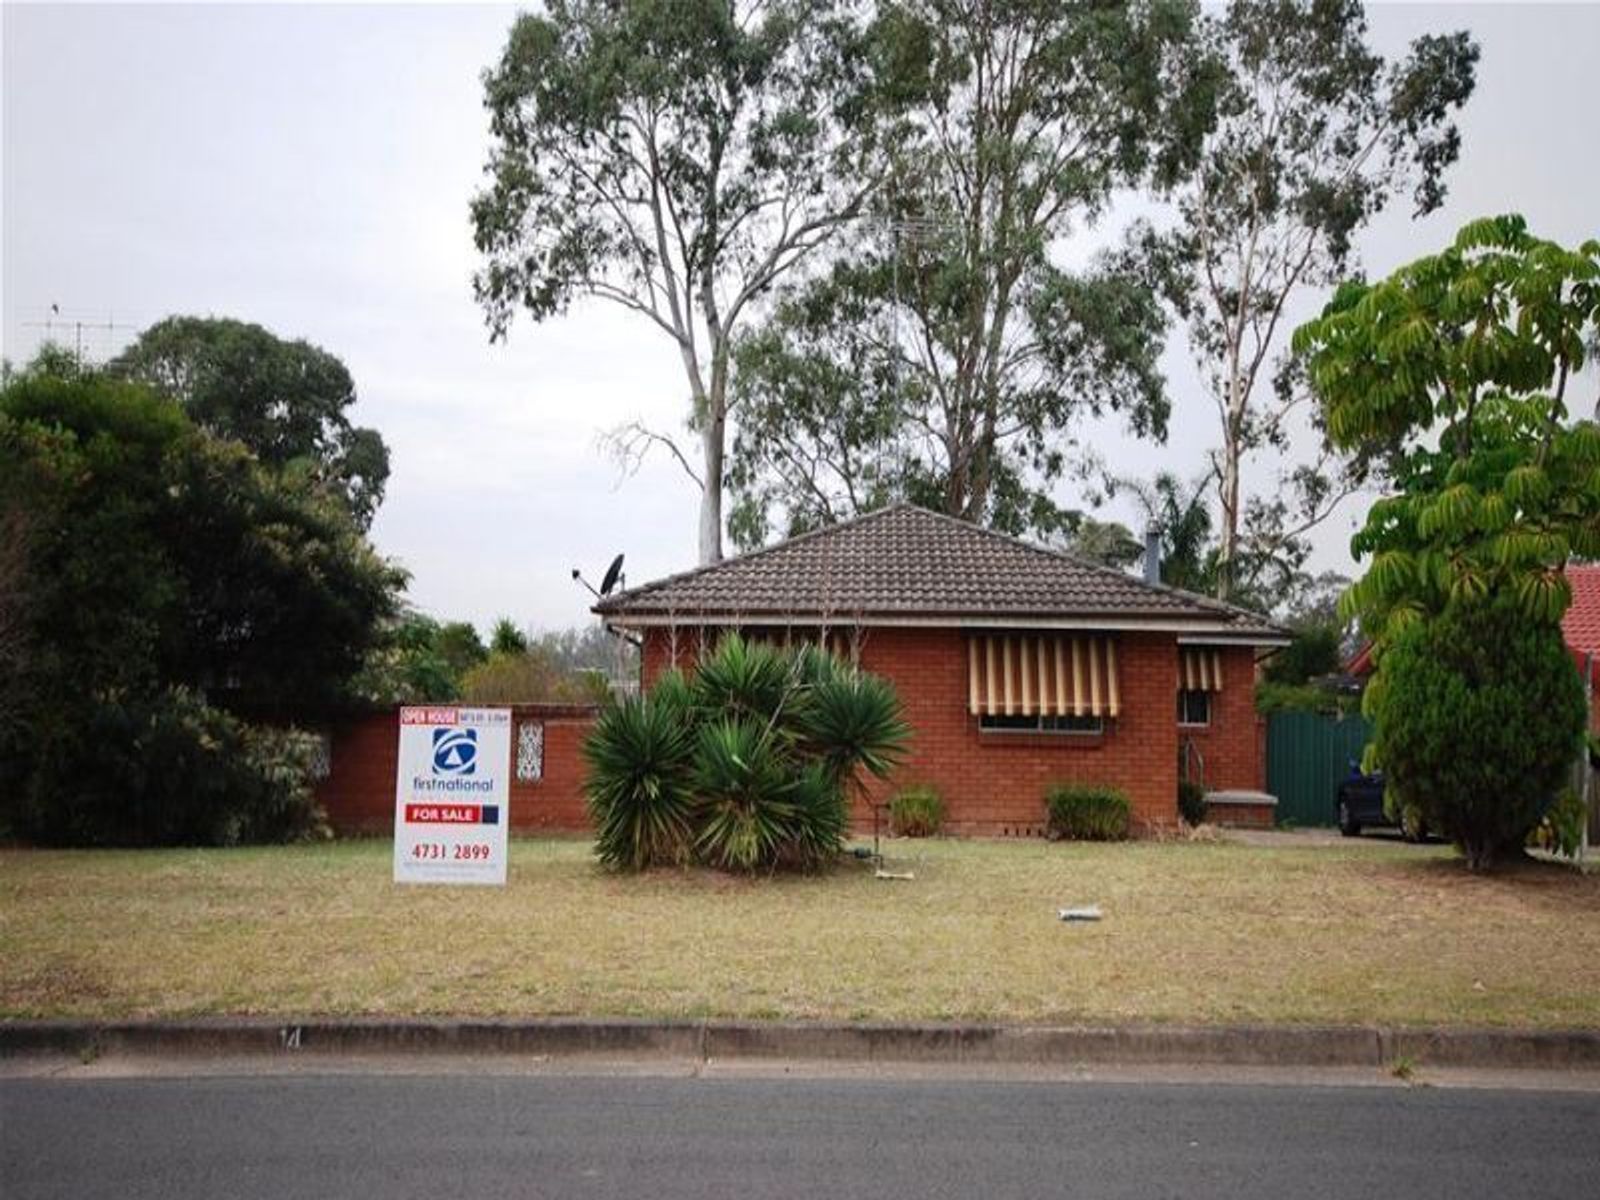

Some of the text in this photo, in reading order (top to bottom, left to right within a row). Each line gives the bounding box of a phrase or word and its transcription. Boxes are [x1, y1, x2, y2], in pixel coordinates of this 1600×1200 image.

[402, 709, 425, 723] OPEN
[428, 709, 457, 723] HOUSE
[412, 808, 474, 821] FOR SALE
[412, 844, 490, 859] 4731 2899
